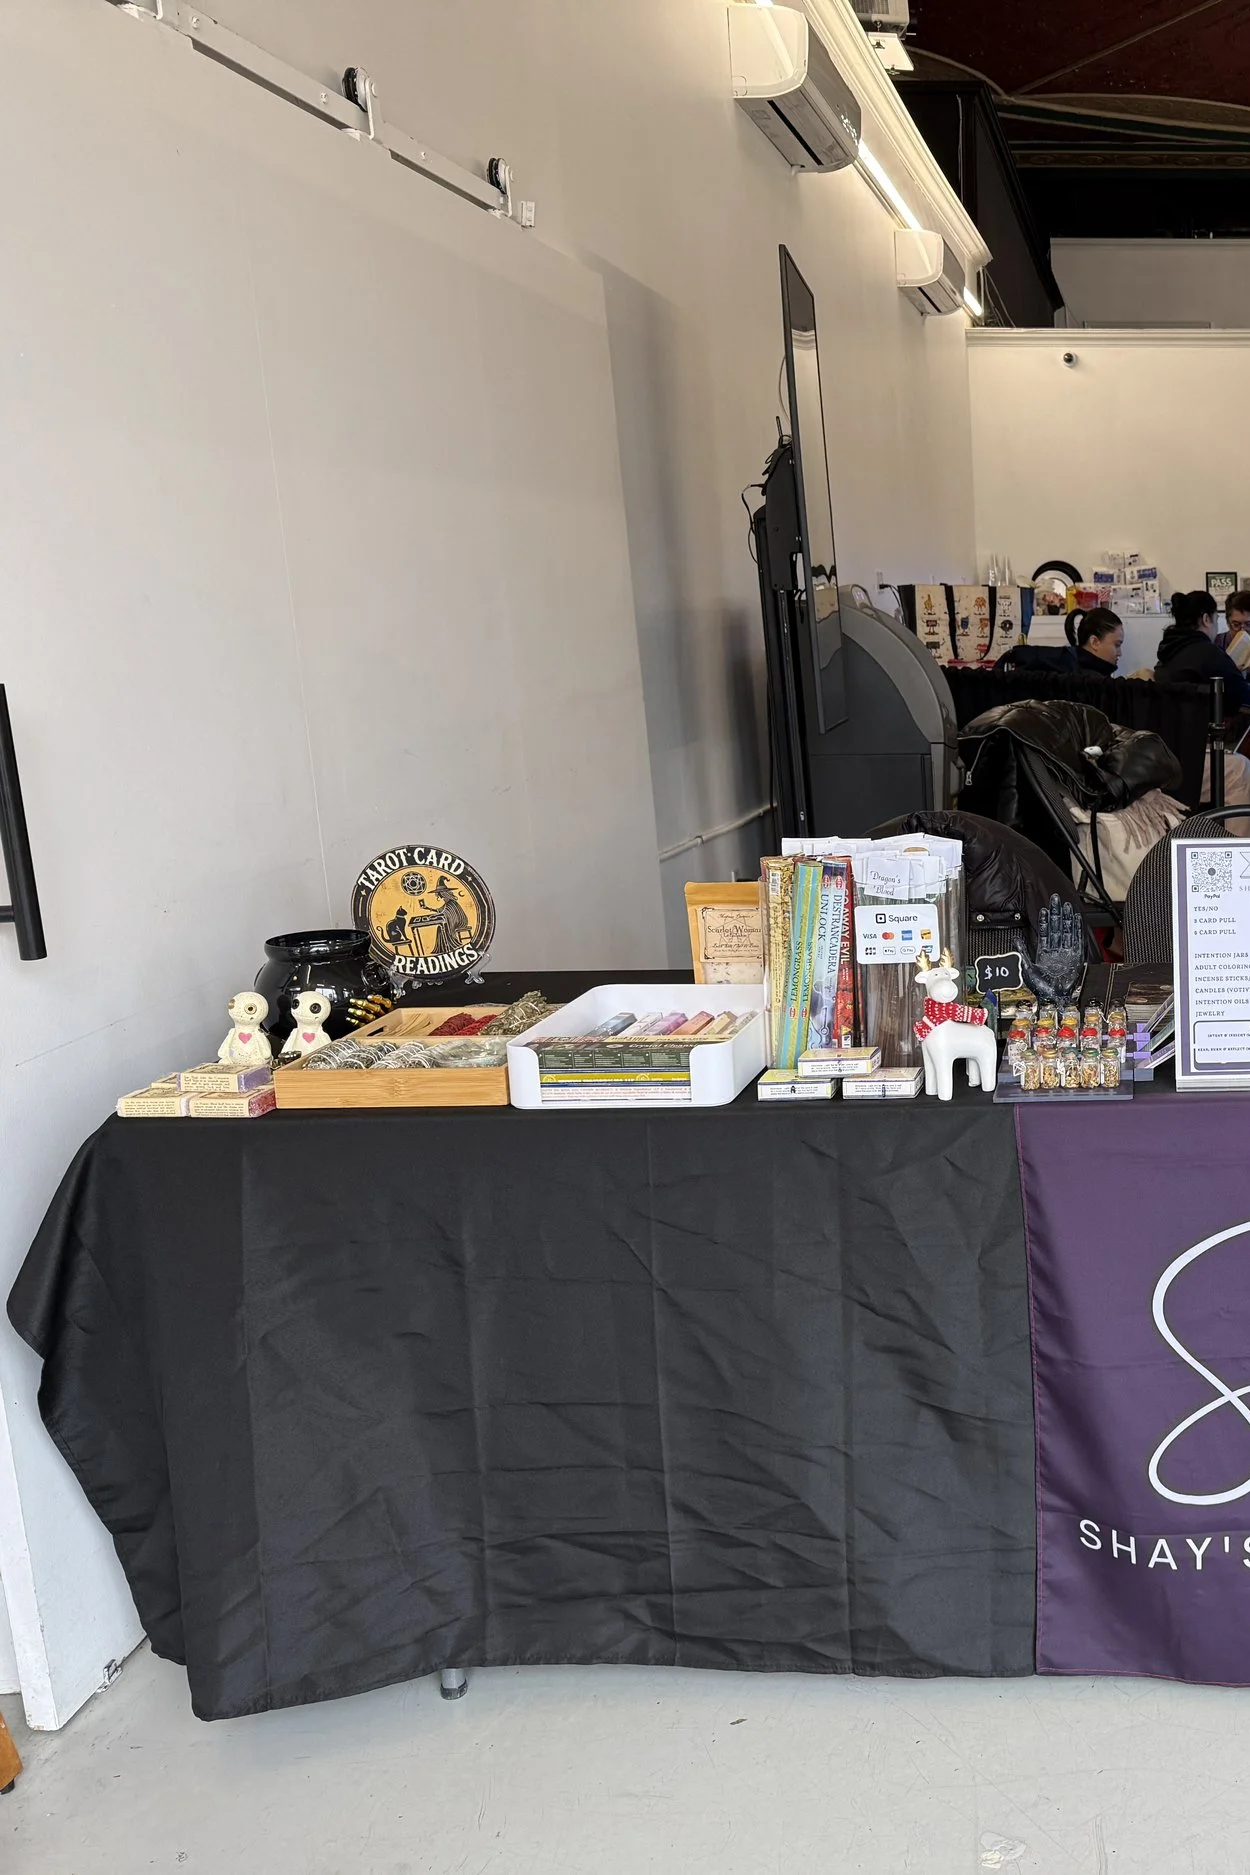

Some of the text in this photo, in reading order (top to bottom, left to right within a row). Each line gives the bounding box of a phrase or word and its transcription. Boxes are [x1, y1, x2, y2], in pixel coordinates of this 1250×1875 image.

[1211, 579, 1232, 587] PASS
[358, 848, 465, 890] TAROT CARD
[871, 871, 900, 885] Dragon's
[874, 886, 895, 895] Blood
[818, 894, 829, 941] UNLOCK
[842, 908, 850, 939] AWAY
[888, 915, 918, 923] Square
[828, 895, 842, 973] DESTRANCADERA
[393, 945, 478, 974] READINGS
[840, 942, 850, 965] EVIL
[791, 941, 802, 1001] LEMONGRASS
[984, 965, 1009, 980] $10
